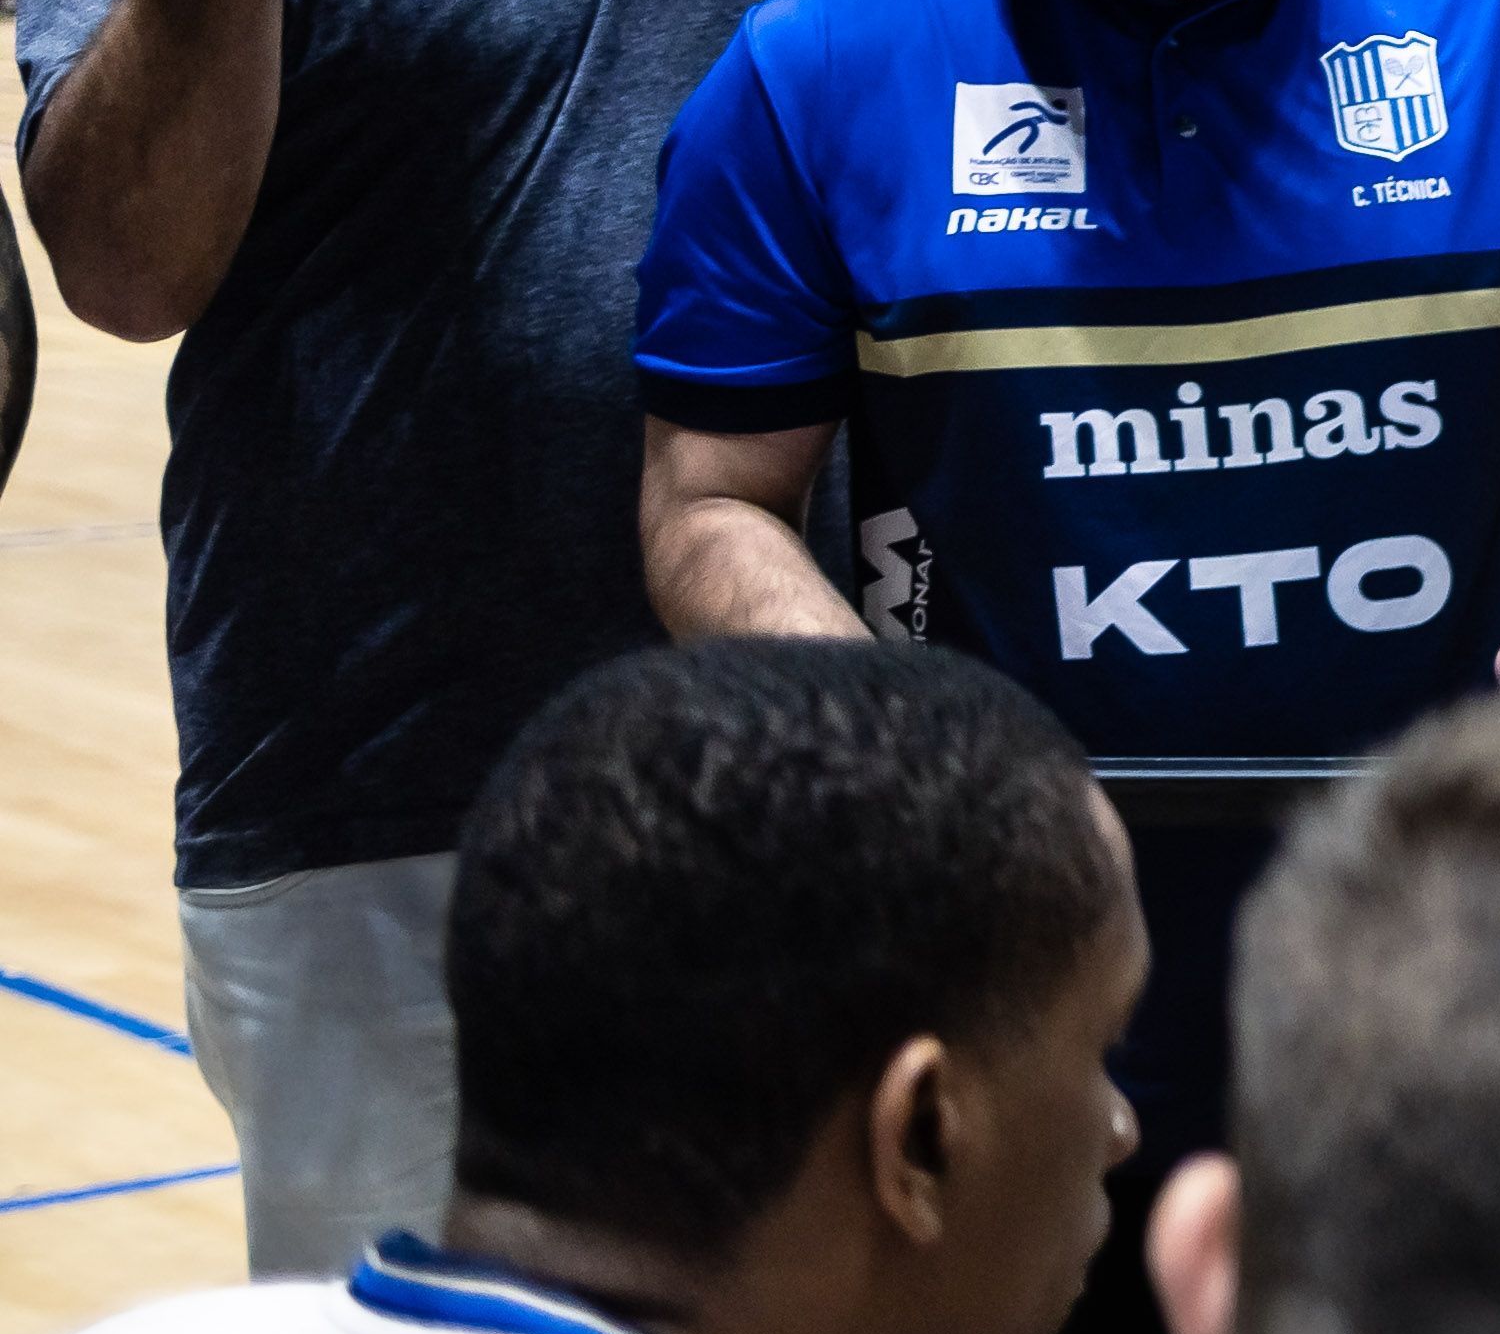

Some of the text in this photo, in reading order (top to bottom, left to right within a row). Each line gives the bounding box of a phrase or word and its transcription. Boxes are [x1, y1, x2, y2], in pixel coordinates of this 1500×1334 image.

[1372, 175, 1451, 204] TÉCNICA
[1040, 379, 1443, 479] minas
[1052, 534, 1453, 660] KTO
